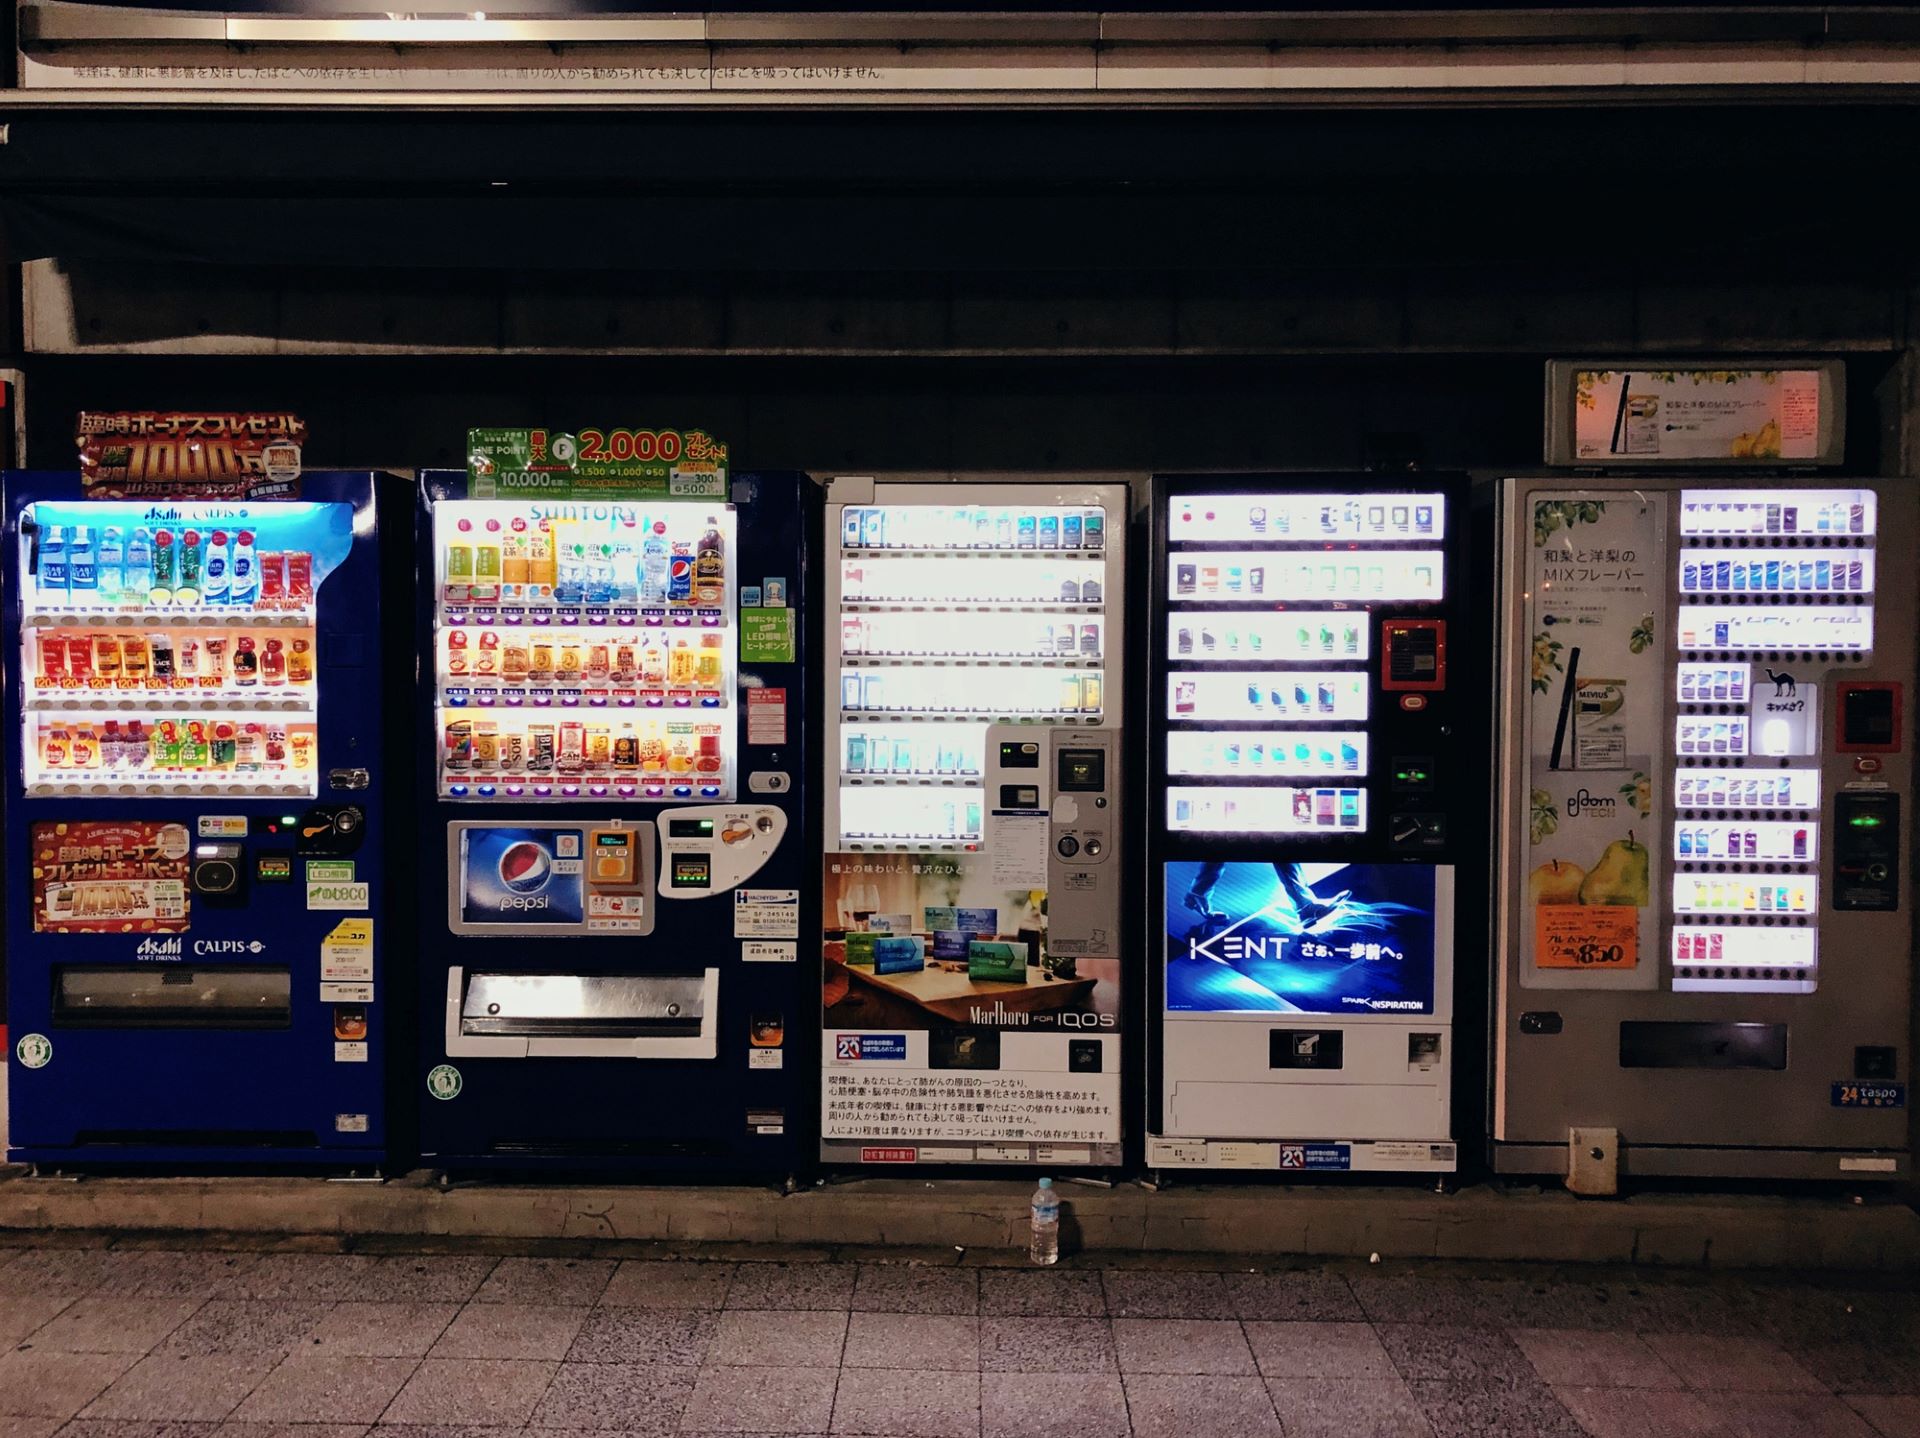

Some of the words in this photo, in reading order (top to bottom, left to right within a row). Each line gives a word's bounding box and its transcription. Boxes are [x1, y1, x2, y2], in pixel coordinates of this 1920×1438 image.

[579, 430, 682, 464] 2,000
[144, 506, 183, 521] Asahi
[1543, 549, 1635, 563] 和梨と洋梨の
[1543, 568, 1645, 581] MIXフレーバー
[1578, 690, 1608, 700] MEVIUS
[541, 735, 553, 766] BLAC
[831, 863, 974, 875] 極上の味わいと、贅沢なひと
[500, 894, 549, 912] pepsi
[136, 937, 183, 954] Asahi
[193, 940, 246, 956] CALPIS
[1190, 937, 1290, 961] KENT
[137, 954, 155, 962] SOFT
[156, 954, 183, 962] DRINKS
[1371, 1001, 1423, 1011] INSPIRATION
[970, 1001, 1030, 1027] Marlboro
[1034, 1016, 1053, 1024] FOR
[1057, 1012, 1115, 1029] IQOS
[829, 1076, 1029, 1089] 喫煙は、あなたにとって肺がんの原因の一つとなり、
[829, 1086, 1100, 1101] 心筋梗塞・脳卒中の危険性や肺気腫を悪化させる危険性を高めます。
[1860, 1087, 1897, 1100] taspo
[829, 1101, 1112, 1116] 未成年者の喫煙は、健康に対する悪影響やたばこへの依存をより強めます。
[829, 1110, 1037, 1124] 周りの人から勧められても決して吸ってはいけません。
[830, 1126, 1108, 1141] 人により程度は異なりますが、ニコチンにより喫煙への依存が生じます。
